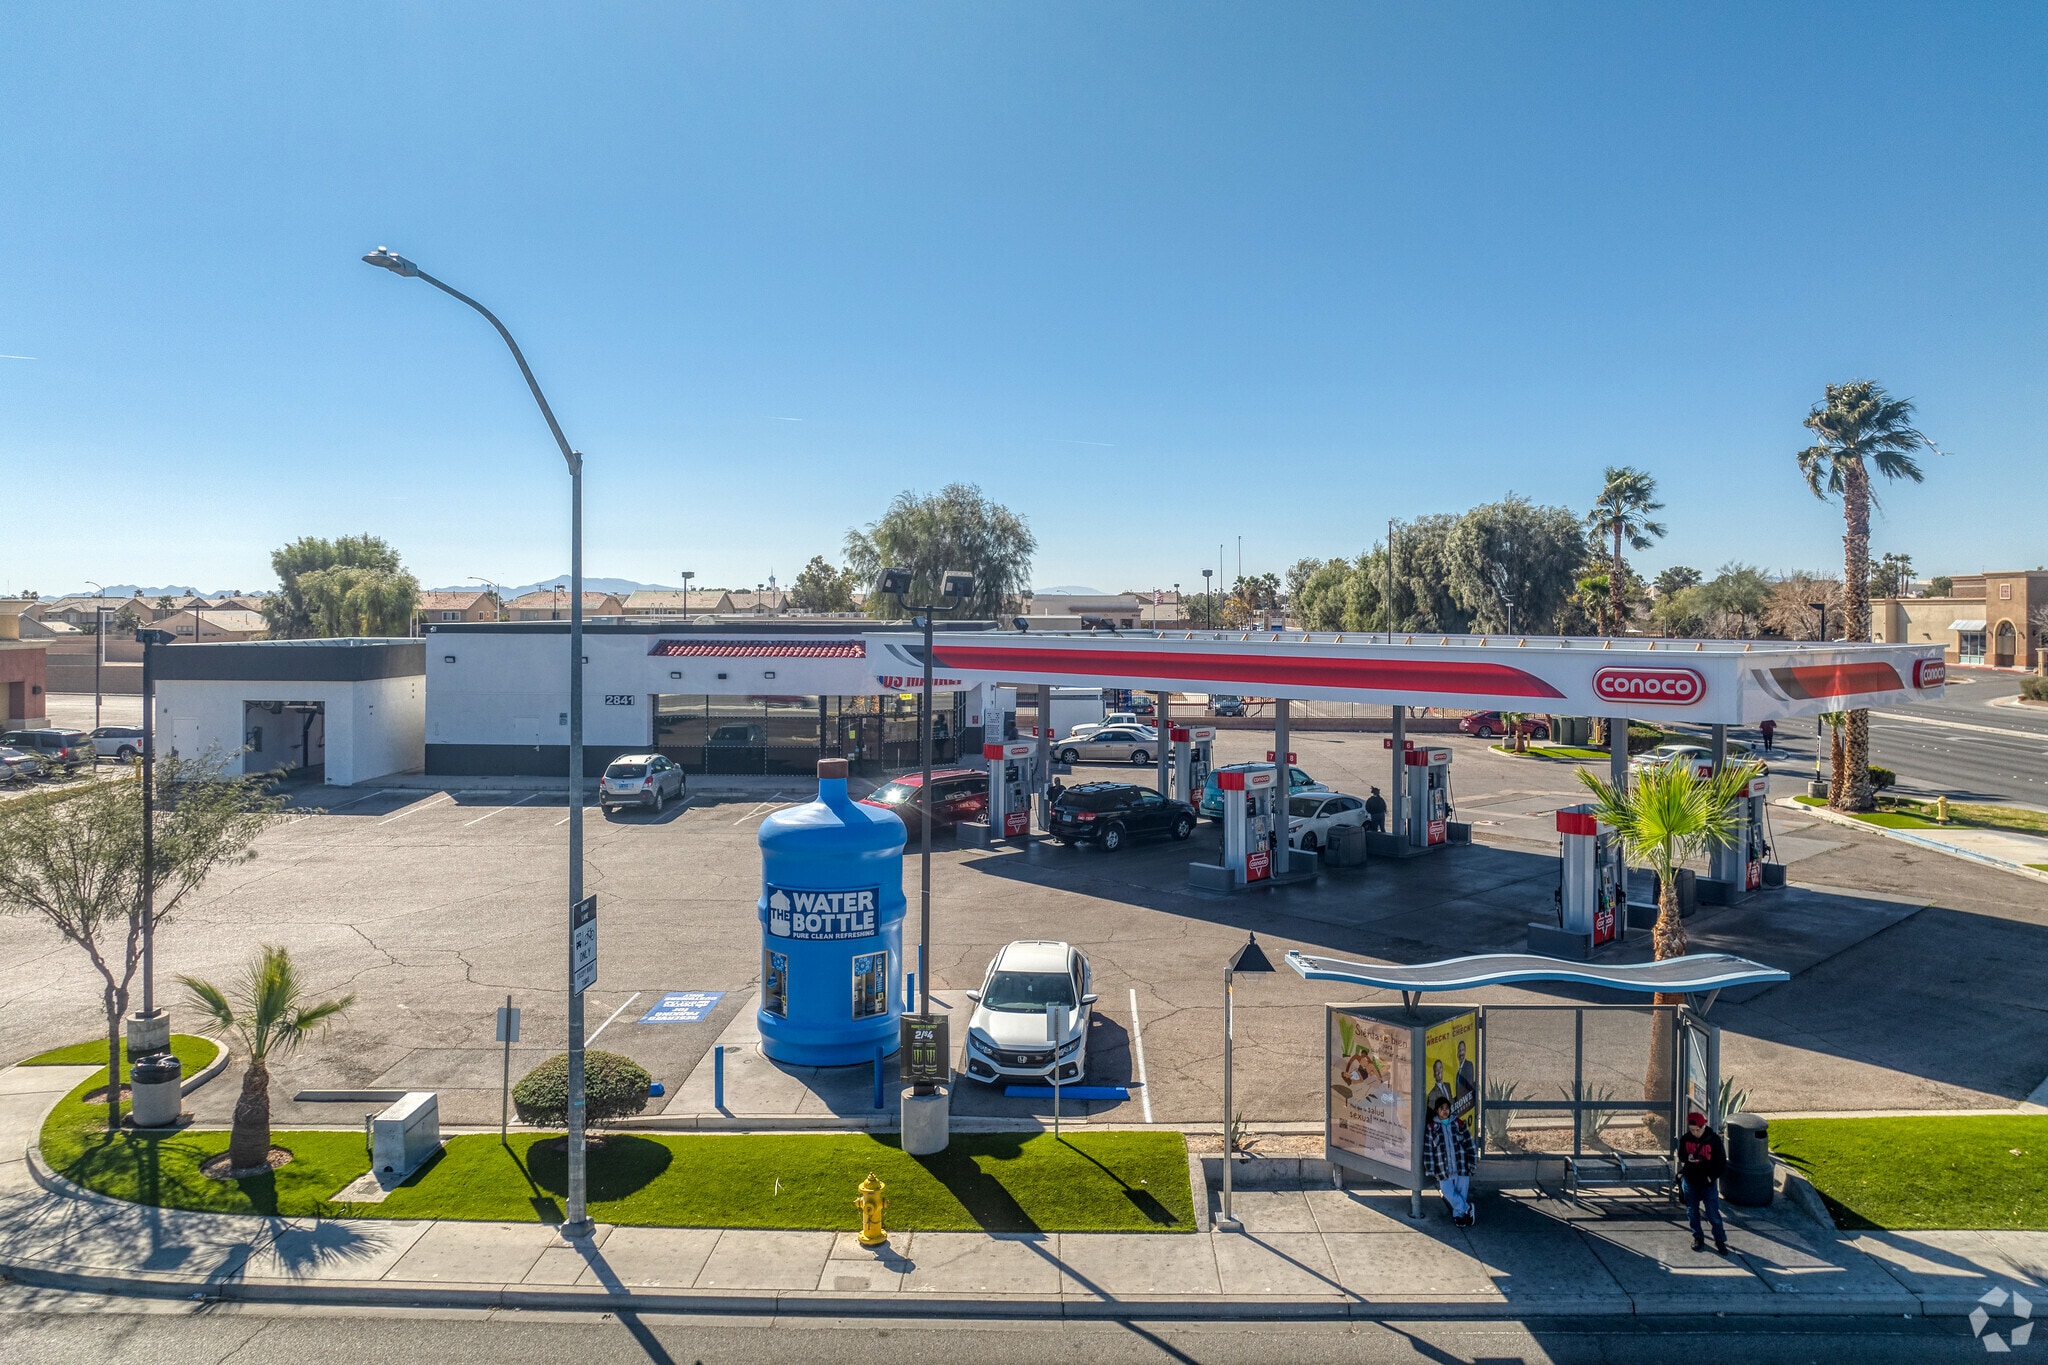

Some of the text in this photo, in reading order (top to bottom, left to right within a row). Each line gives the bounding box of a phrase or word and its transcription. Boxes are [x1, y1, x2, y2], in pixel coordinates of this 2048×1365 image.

[606, 696, 634, 704] 2841
[792, 891, 873, 913] WATER
[770, 908, 790, 921] THE
[793, 911, 874, 932] BOTTLE
[811, 932, 834, 940] CLEAN
[835, 930, 874, 939] REFRESHING
[579, 947, 592, 963] ONLY
[1355, 1023, 1408, 1049] Siéntase bien
[1455, 1090, 1473, 1109] ROWE
[1349, 1111, 1372, 1124] sexual
[1367, 1106, 1385, 1117] salud
